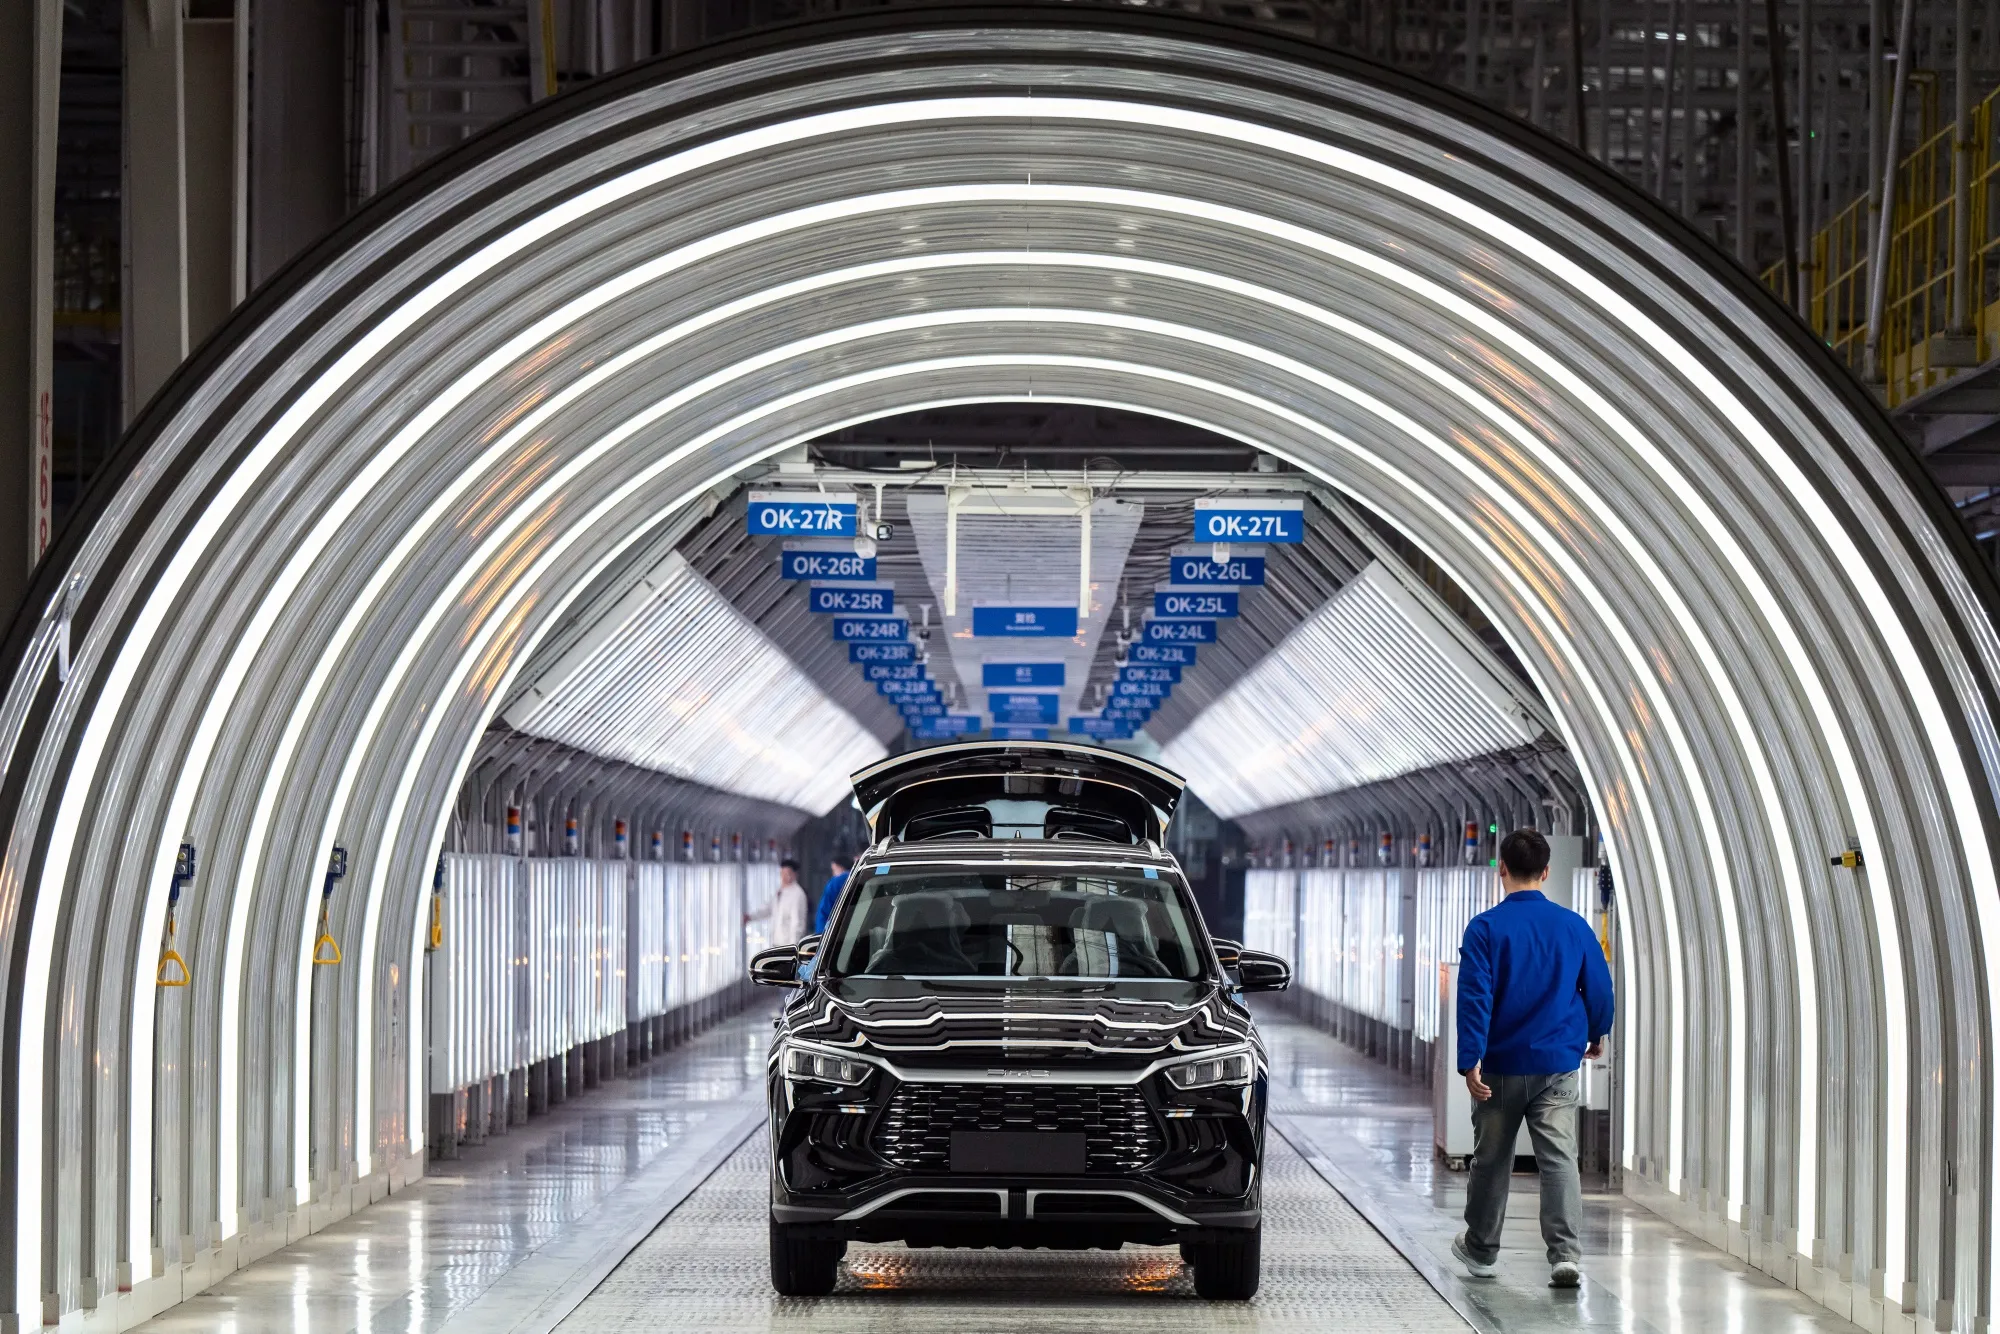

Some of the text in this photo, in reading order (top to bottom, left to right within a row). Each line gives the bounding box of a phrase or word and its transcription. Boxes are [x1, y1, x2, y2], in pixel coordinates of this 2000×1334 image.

[760, 507, 843, 531] OK-27R
[1208, 515, 1289, 537] OK-27L
[793, 556, 865, 576] OK-26R
[1182, 562, 1252, 580] OK-26L
[819, 592, 883, 610] OK-25R
[1165, 597, 1226, 613] OK-25L
[842, 622, 899, 638] OK-24R
[1150, 625, 1206, 640] OK-24L
[856, 646, 909, 660] OK-23R
[1137, 646, 1187, 661] OK-23L
[1126, 668, 1173, 681] OK-22L
